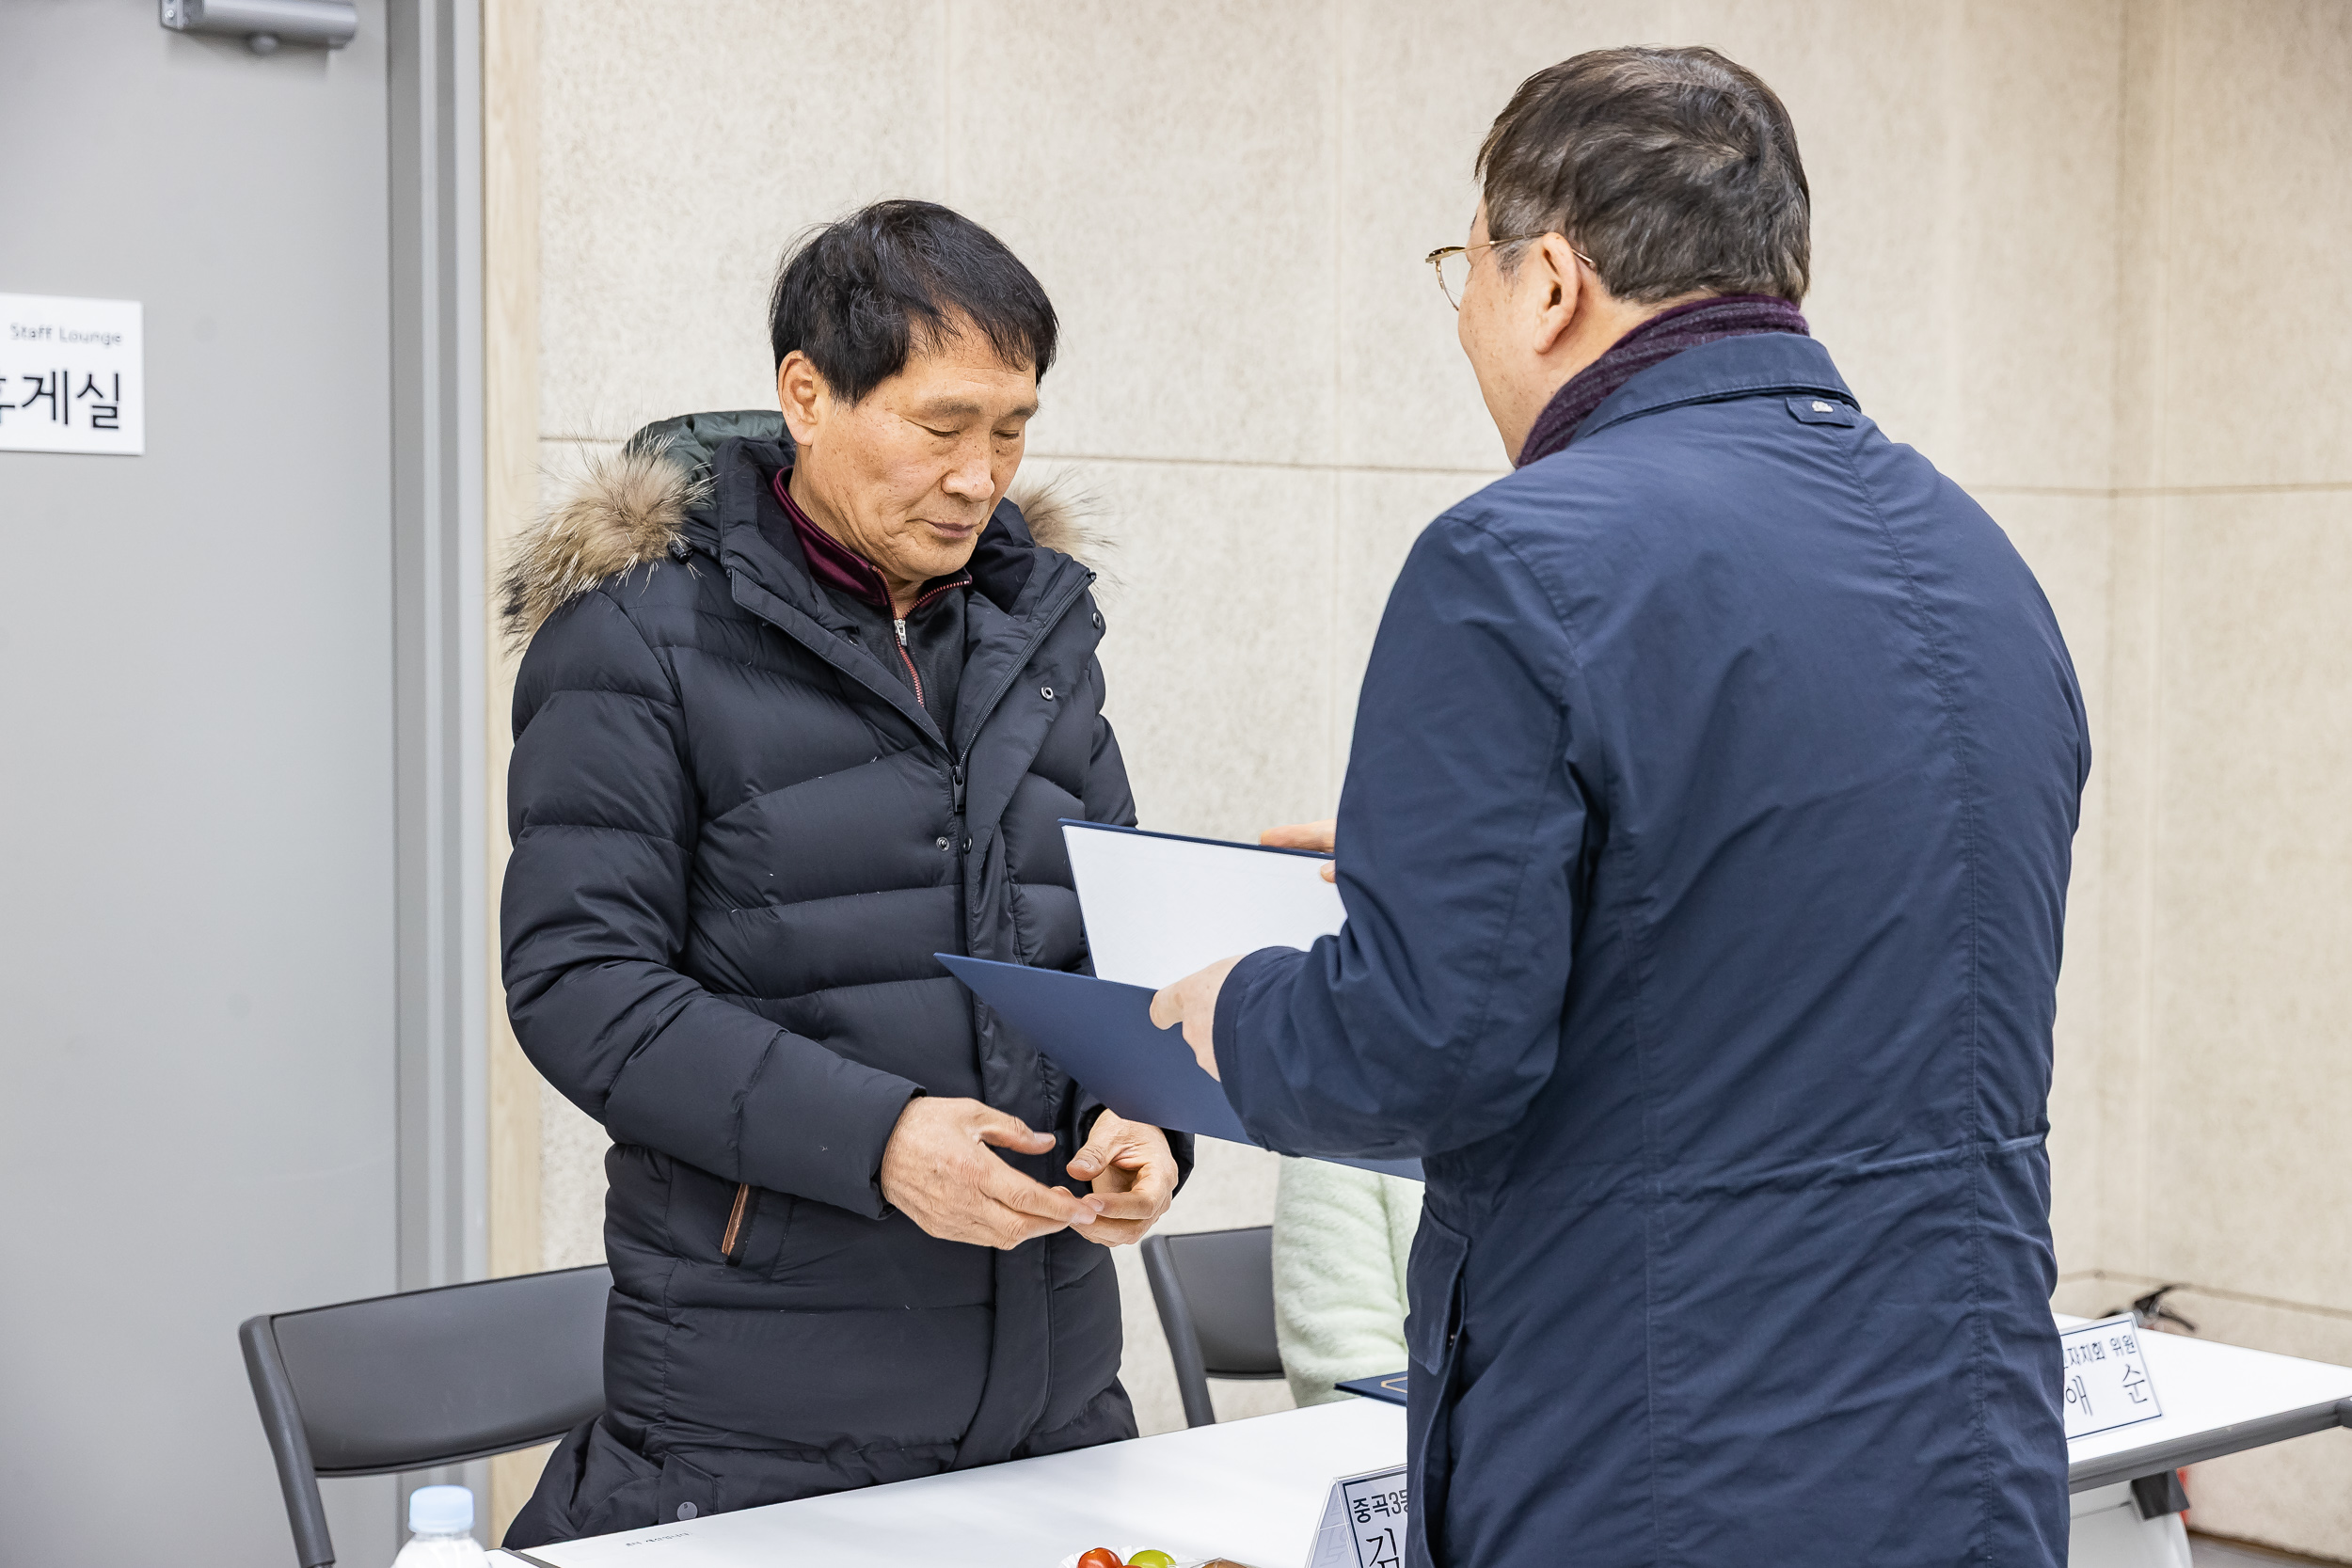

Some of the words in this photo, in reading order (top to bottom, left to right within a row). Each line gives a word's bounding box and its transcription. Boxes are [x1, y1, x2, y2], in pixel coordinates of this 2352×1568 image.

[9, 324, 53, 341] Staff
[59, 326, 123, 347] Lounge
[2109, 1335, 2137, 1356] 위원
